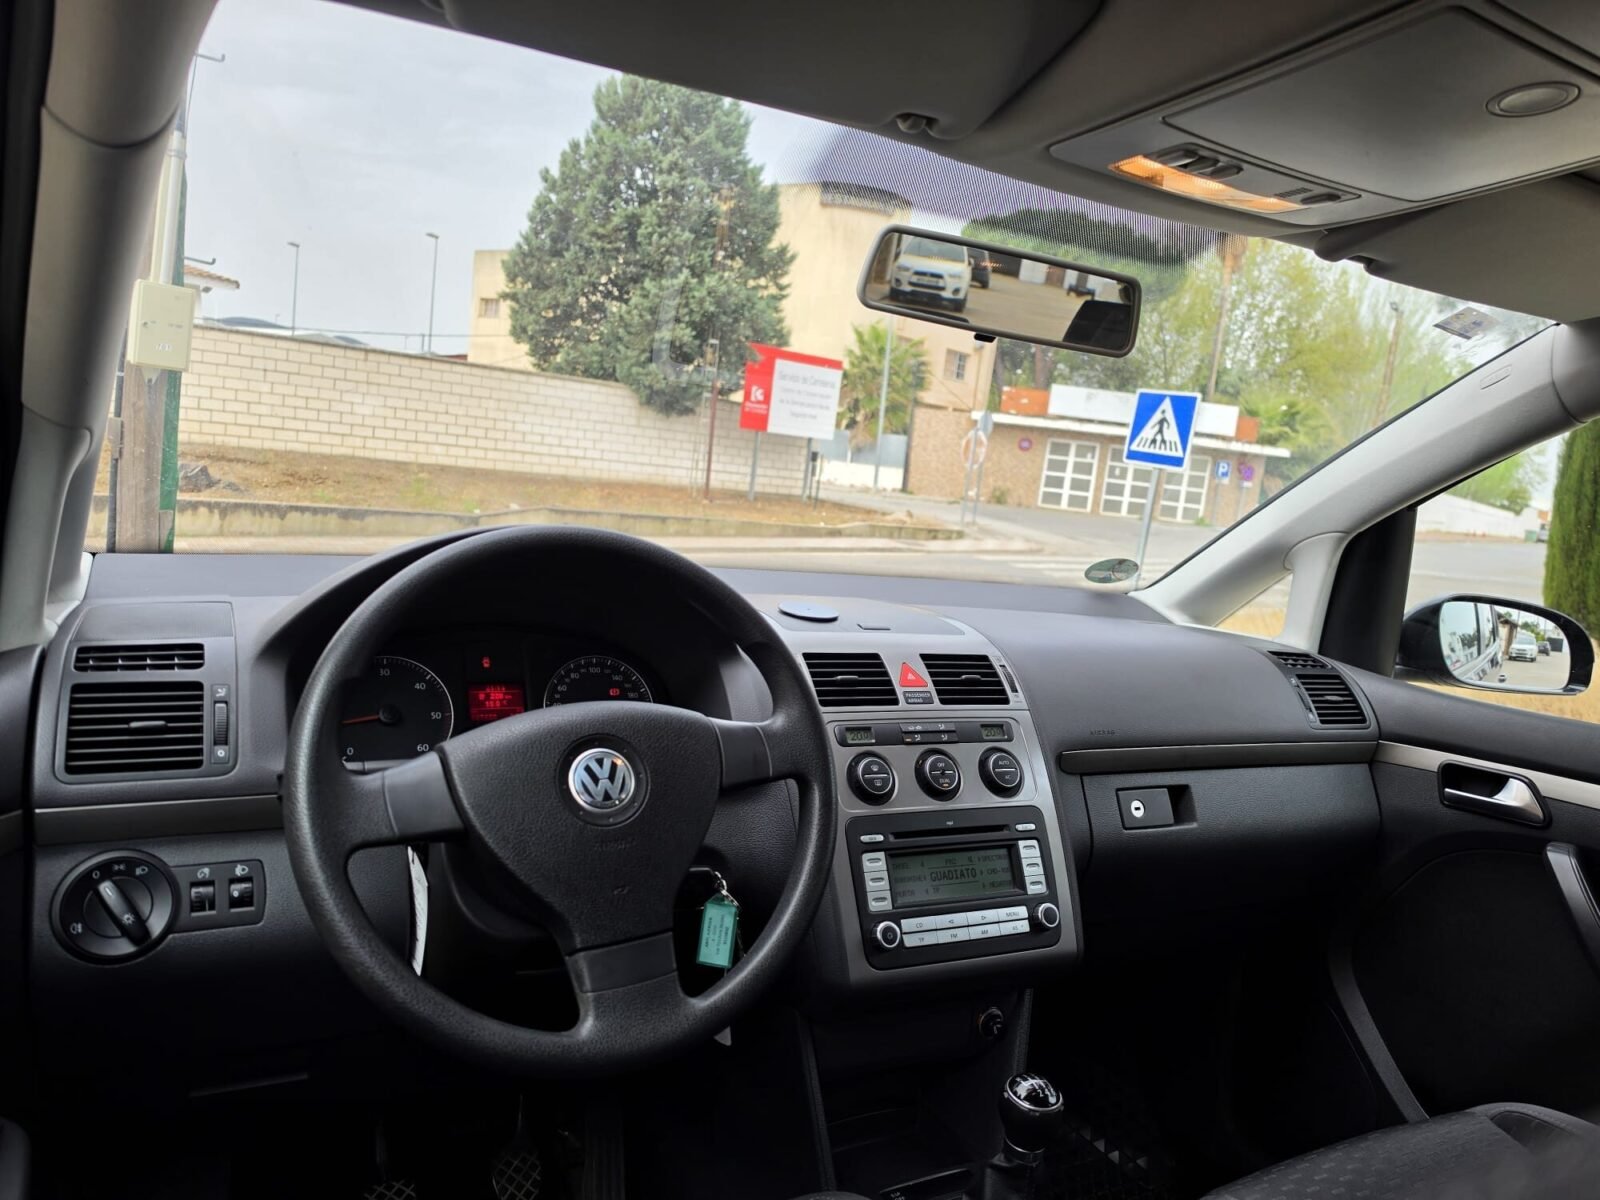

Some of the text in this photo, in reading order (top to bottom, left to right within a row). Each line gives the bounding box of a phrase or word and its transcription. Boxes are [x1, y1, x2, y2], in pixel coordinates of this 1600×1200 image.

[1219, 462, 1228, 477] P
[379, 668, 390, 676] 30
[414, 682, 426, 690] 40
[430, 711, 442, 720] 50
[346, 746, 354, 755] 0
[416, 743, 429, 752] 60
[570, 750, 633, 810] VW
[930, 868, 977, 882] GUADIATO
